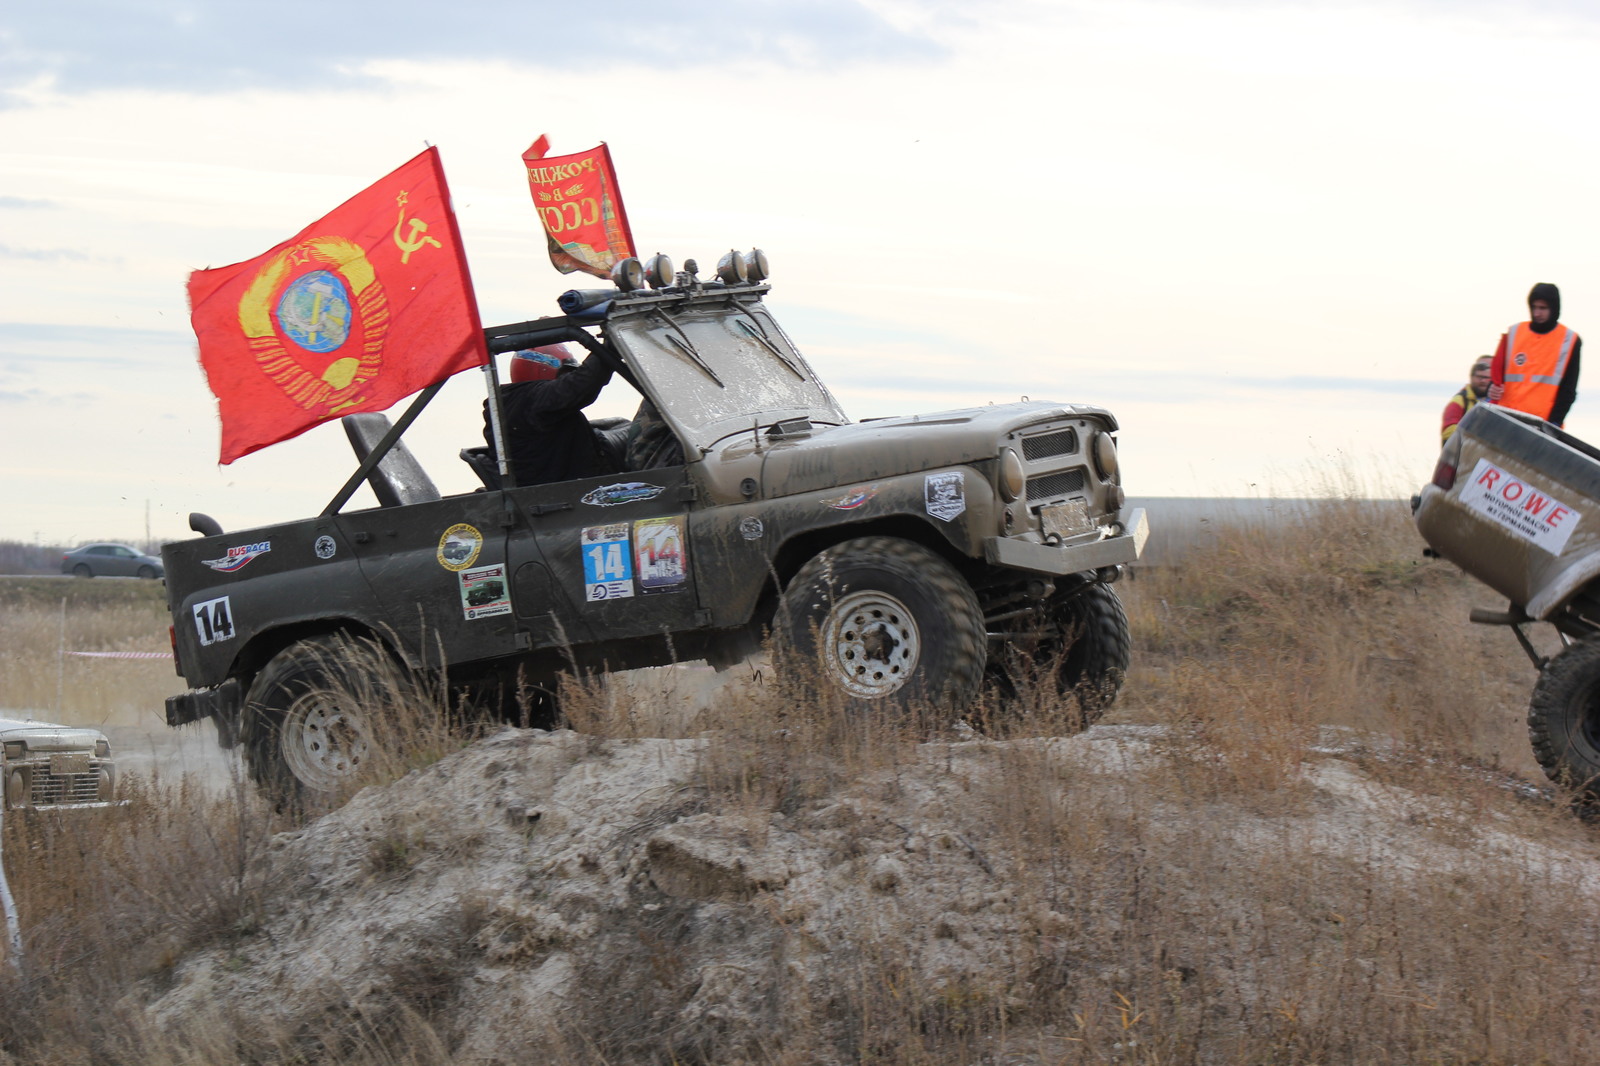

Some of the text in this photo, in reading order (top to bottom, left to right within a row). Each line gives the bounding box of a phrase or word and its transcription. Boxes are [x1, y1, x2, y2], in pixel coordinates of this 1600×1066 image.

[1478, 468, 1569, 528] ROWE
[1483, 492, 1550, 534] МОТОРНОЕ МАСЛО
[1497, 510, 1537, 537] ГЕРМАНИИ
[228, 542, 269, 557] RUSRACE
[588, 543, 625, 581] 14
[641, 536, 679, 566] 14
[196, 600, 232, 641] 14
